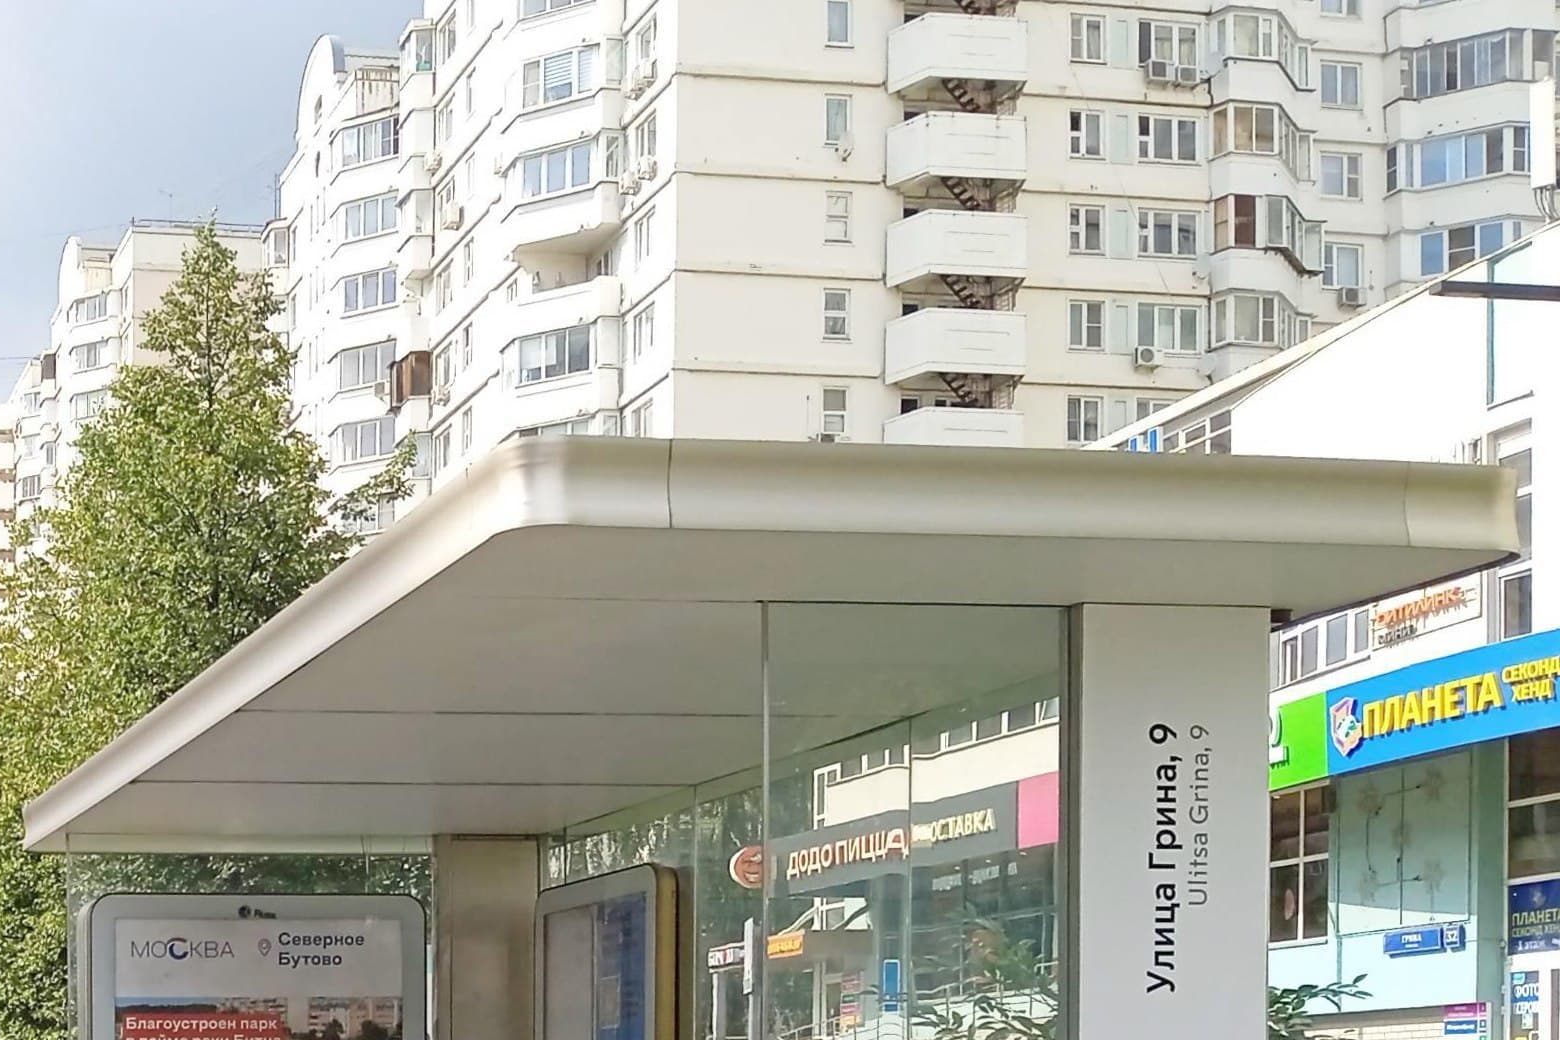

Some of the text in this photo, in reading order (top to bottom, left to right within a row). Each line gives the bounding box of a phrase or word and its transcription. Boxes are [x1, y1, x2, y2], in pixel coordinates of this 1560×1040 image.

[1502, 655, 1560, 684] СЕКОНД
[1512, 678, 1554, 702] ХЕНД
[1363, 672, 1504, 738] ПЛАНЕТА
[1188, 724, 1213, 906] Ulitsa Grina, 9
[787, 842, 832, 880] ДОДО
[1146, 723, 1183, 993] Улица Грина, 9
[130, 937, 235, 960] МОСКВА
[278, 932, 365, 949] Северное
[278, 952, 343, 968] Бутово
[125, 1016, 278, 1033] Благоустроен парк
